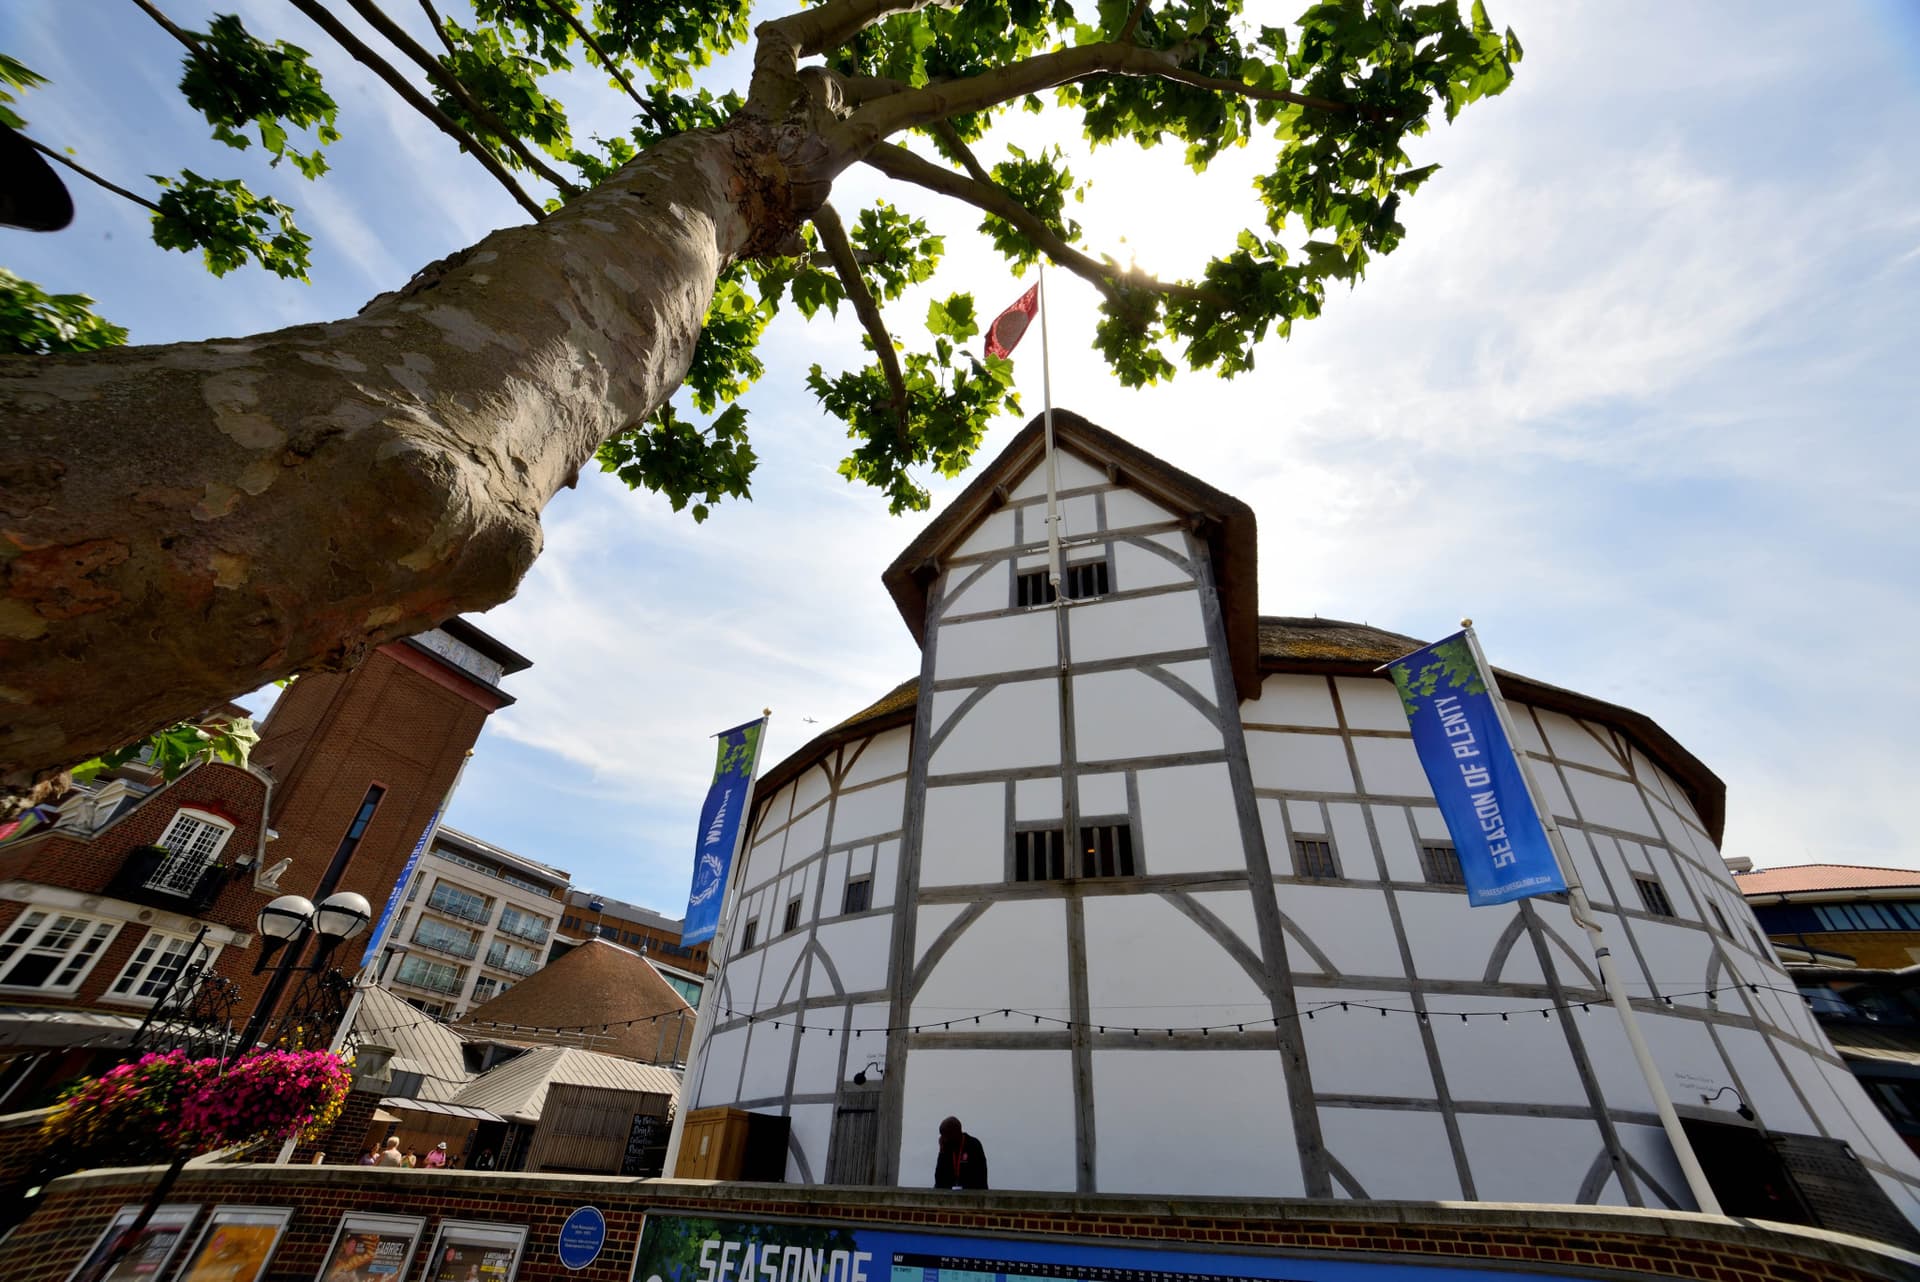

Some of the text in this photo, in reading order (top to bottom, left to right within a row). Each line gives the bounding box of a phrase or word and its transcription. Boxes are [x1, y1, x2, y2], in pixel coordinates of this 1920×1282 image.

[1434, 695, 1516, 868] SEASON OF PLENTY
[697, 1240, 872, 1282] SEASON OF
